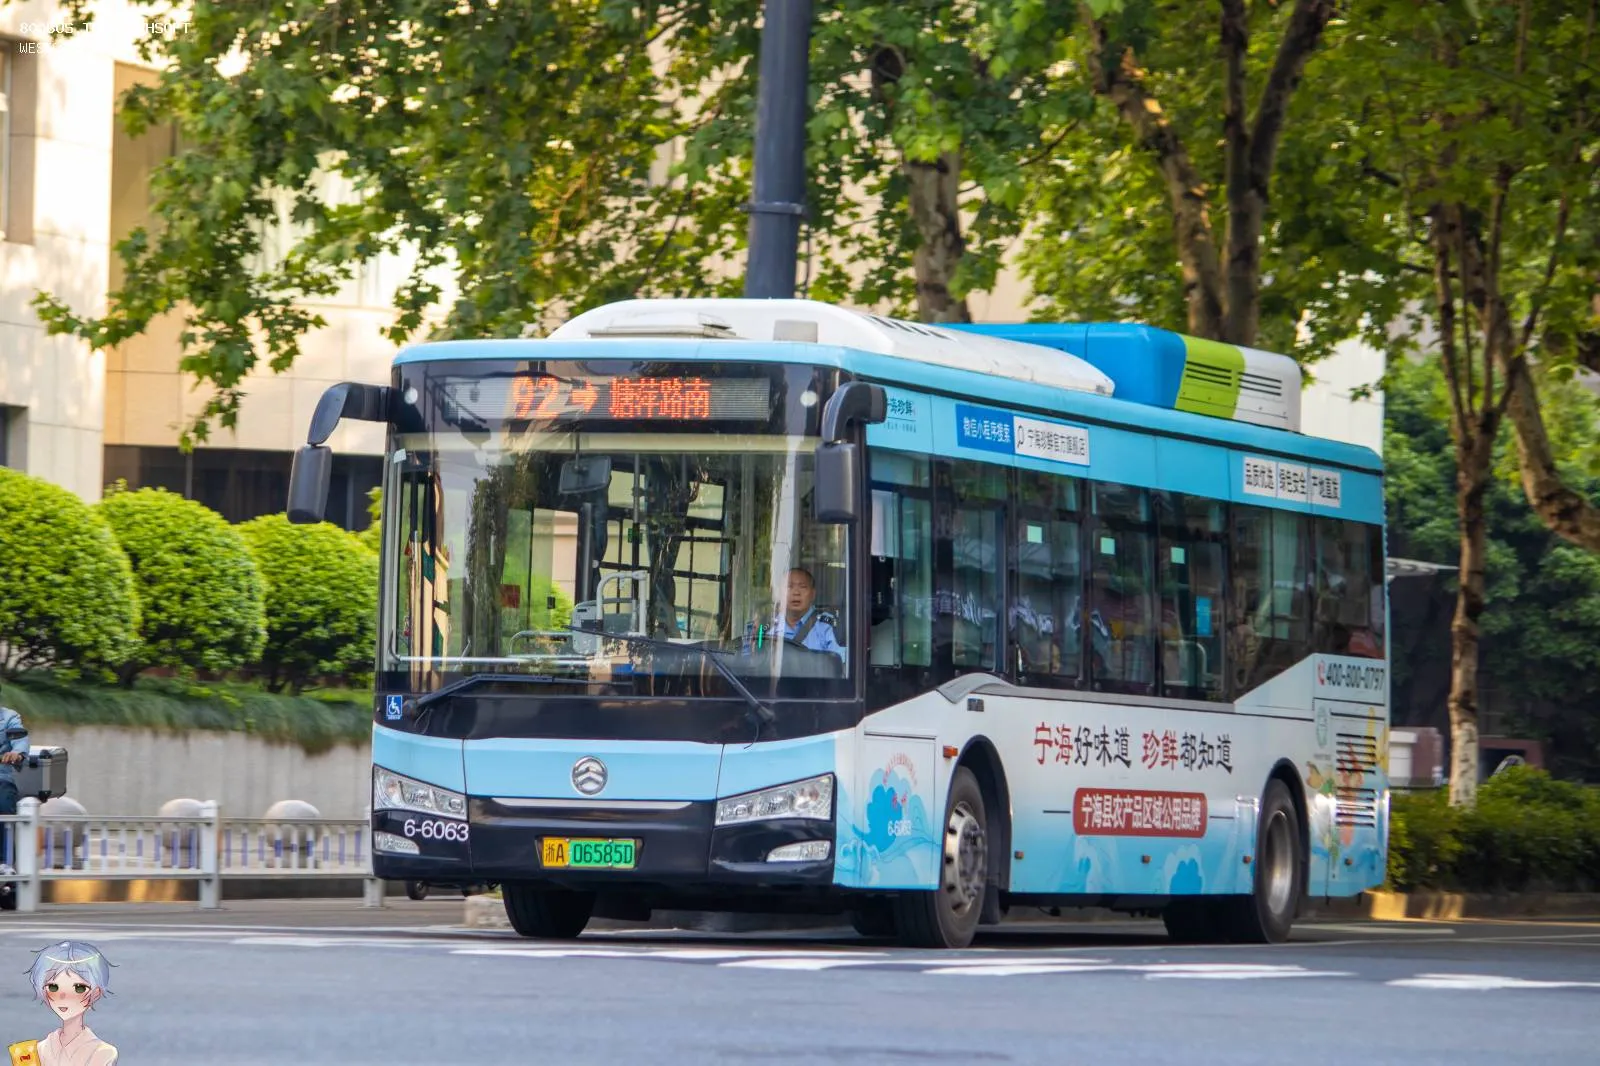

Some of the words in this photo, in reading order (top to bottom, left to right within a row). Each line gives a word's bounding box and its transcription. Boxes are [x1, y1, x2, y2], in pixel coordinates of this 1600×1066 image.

[512, 376, 559, 418] 92
[1034, 721, 1131, 768] 宁海好味道
[1141, 729, 1233, 775] 珍鲜都知道
[404, 819, 469, 841] 6-6063
[1081, 794, 1202, 831] 宁海县农产品区域公用品牌
[545, 843, 565, 863] 浙A
[573, 843, 633, 864] 06585D
